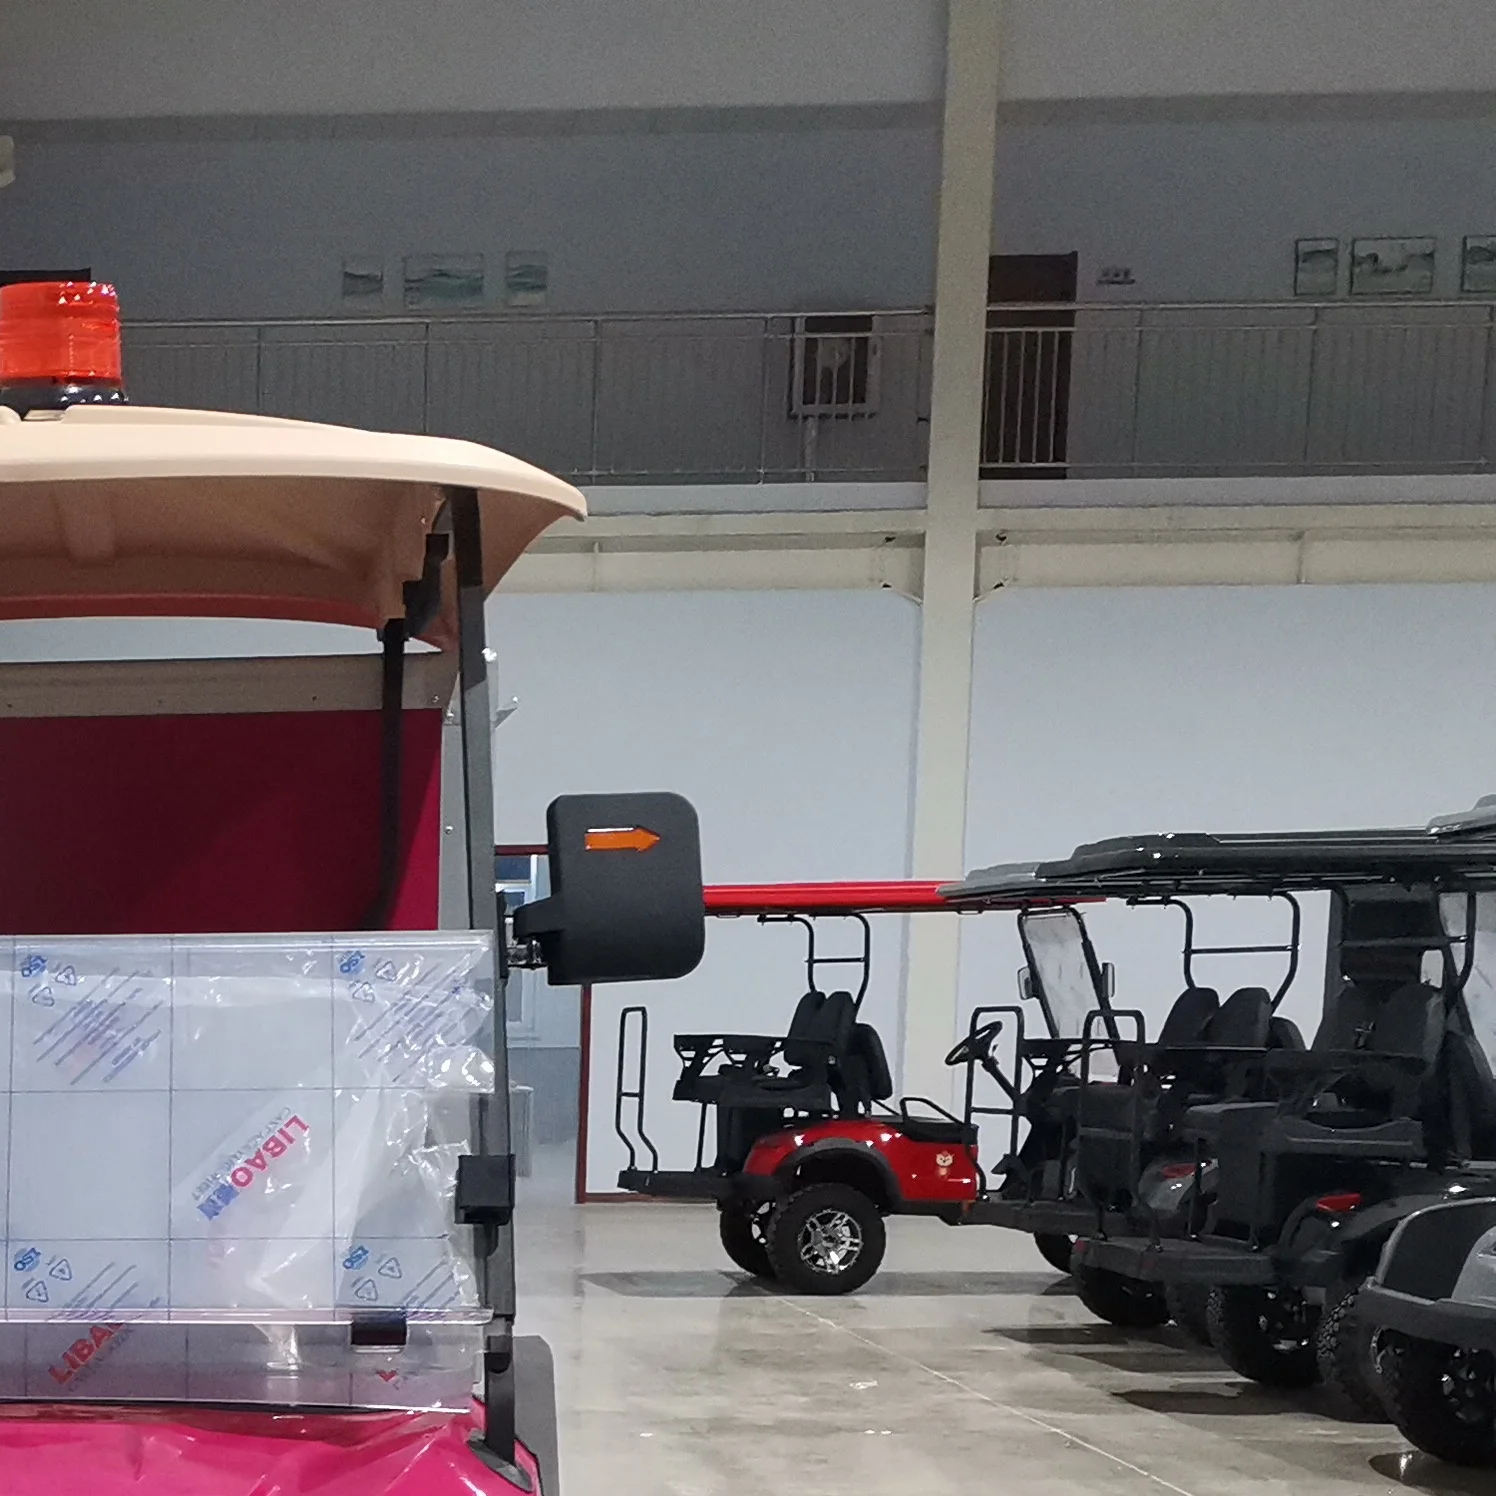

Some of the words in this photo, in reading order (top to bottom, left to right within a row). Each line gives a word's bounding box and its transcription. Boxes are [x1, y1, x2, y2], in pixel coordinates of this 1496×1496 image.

[21, 956, 48, 978] ISO
[340, 951, 365, 973] ISO
[231, 1115, 309, 1187] LIBAO
[14, 1248, 41, 1271] ISO
[342, 1246, 370, 1269] ISO
